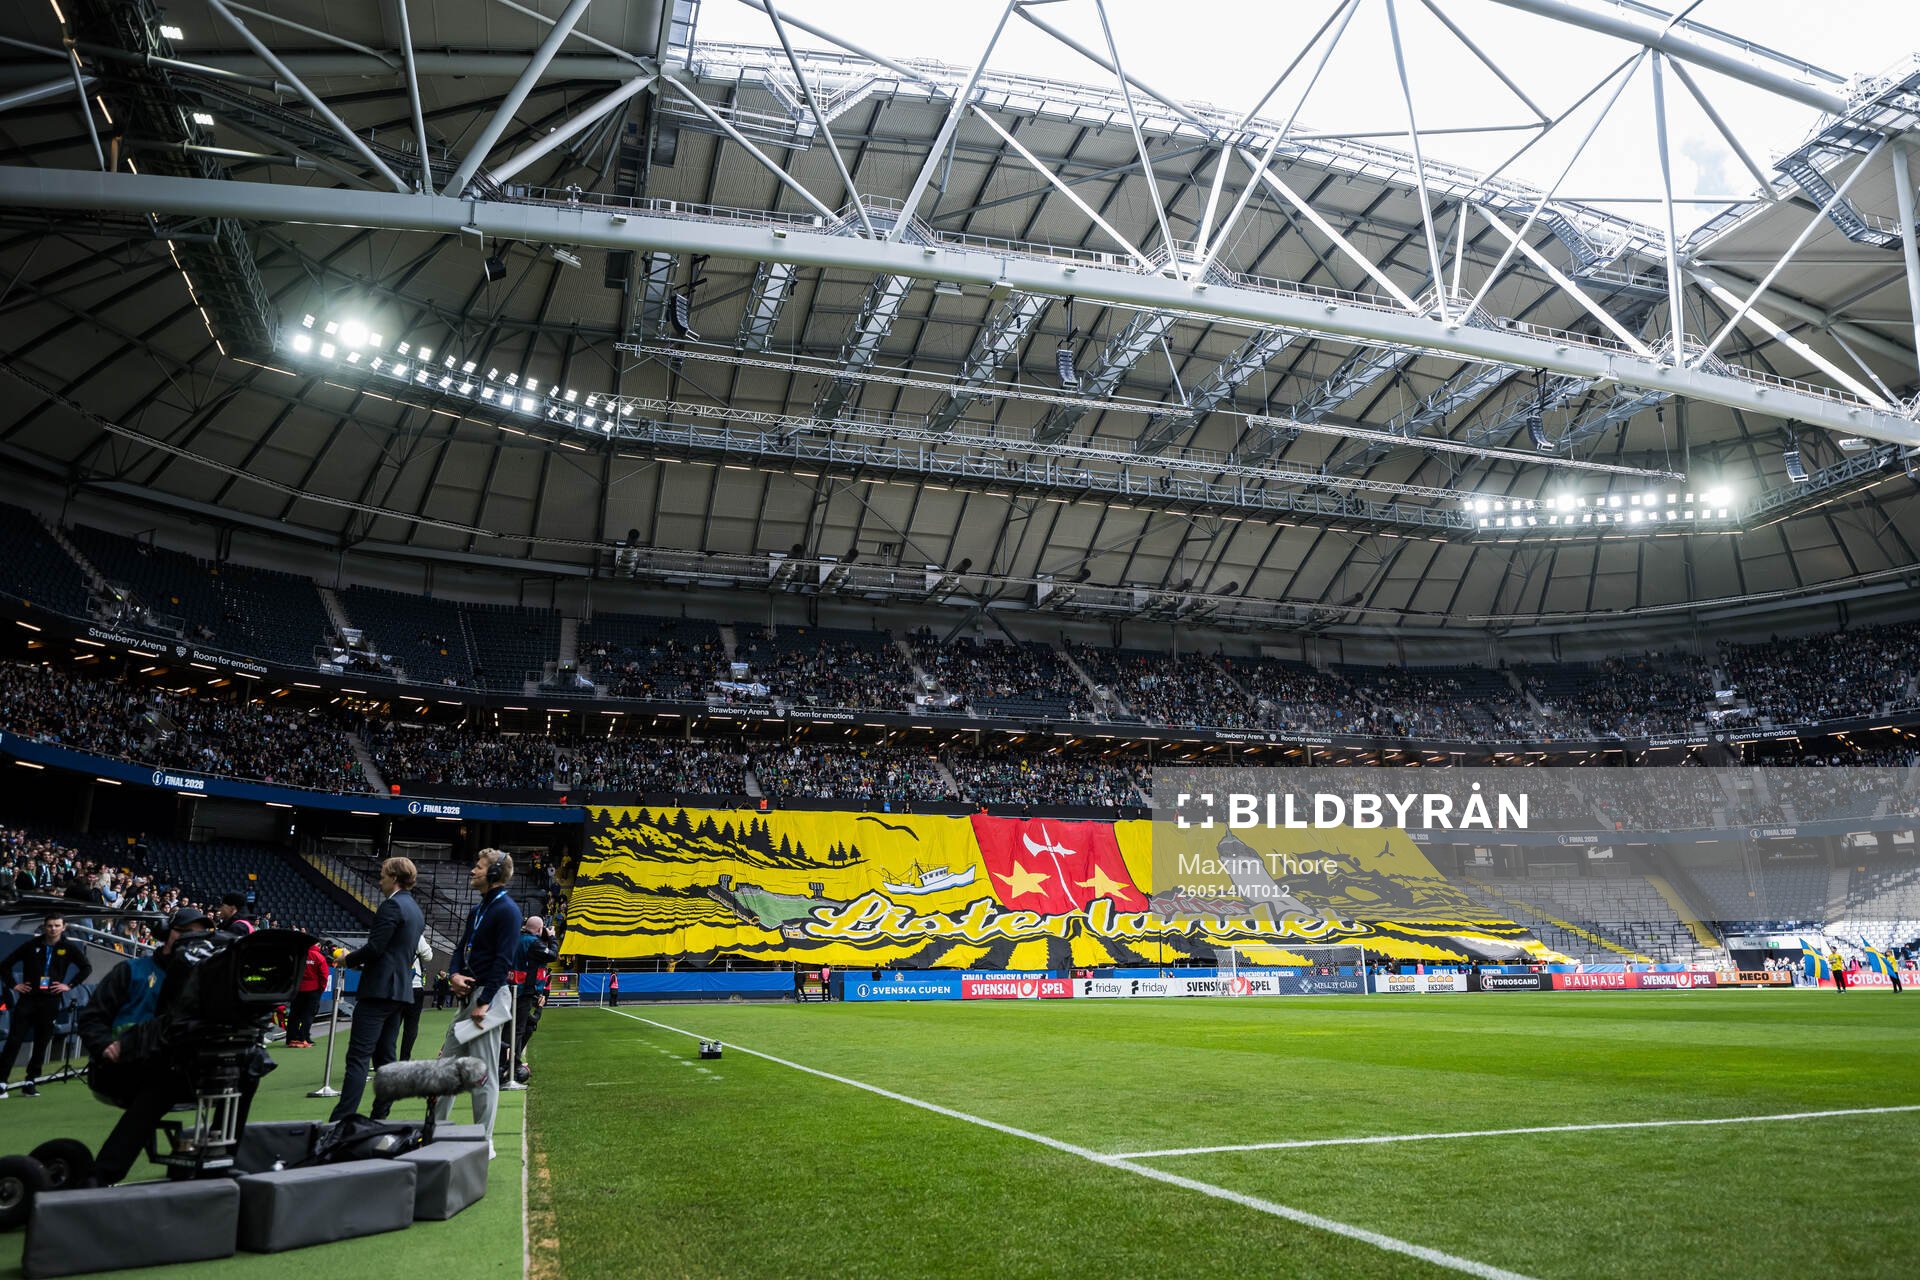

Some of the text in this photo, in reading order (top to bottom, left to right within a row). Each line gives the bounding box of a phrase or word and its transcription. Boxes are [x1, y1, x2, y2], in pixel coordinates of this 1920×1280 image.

[88, 627, 167, 652] Strawberry Arena
[193, 650, 268, 673] Room for emotions
[708, 706, 769, 716] Strawberry Arena
[790, 710, 811, 718] Room
[822, 711, 854, 720] emotions
[1216, 732, 1247, 740] Strawberry
[1751, 731, 1762, 739] for
[1762, 729, 1797, 738] emotions
[1649, 738, 1687, 746] Strawberry
[164, 775, 204, 790] FINAL 2026
[422, 804, 460, 815] FINAL 2026
[1763, 828, 1797, 837] FINAL 2026
[1486, 976, 1538, 986] HYDROSCAND
[1564, 974, 1625, 986] BAUHAUS
[1643, 974, 1711, 985] SVENSKA SPEL
[1739, 972, 1769, 981] HECO
[872, 986, 951, 995] SVENSKA CUPEN
[971, 982, 1064, 996] SVENSKA SPEL
[1095, 983, 1122, 994] friday
[1142, 982, 1168, 993] friday
[1187, 980, 1271, 992] SVENSKA SPEL
